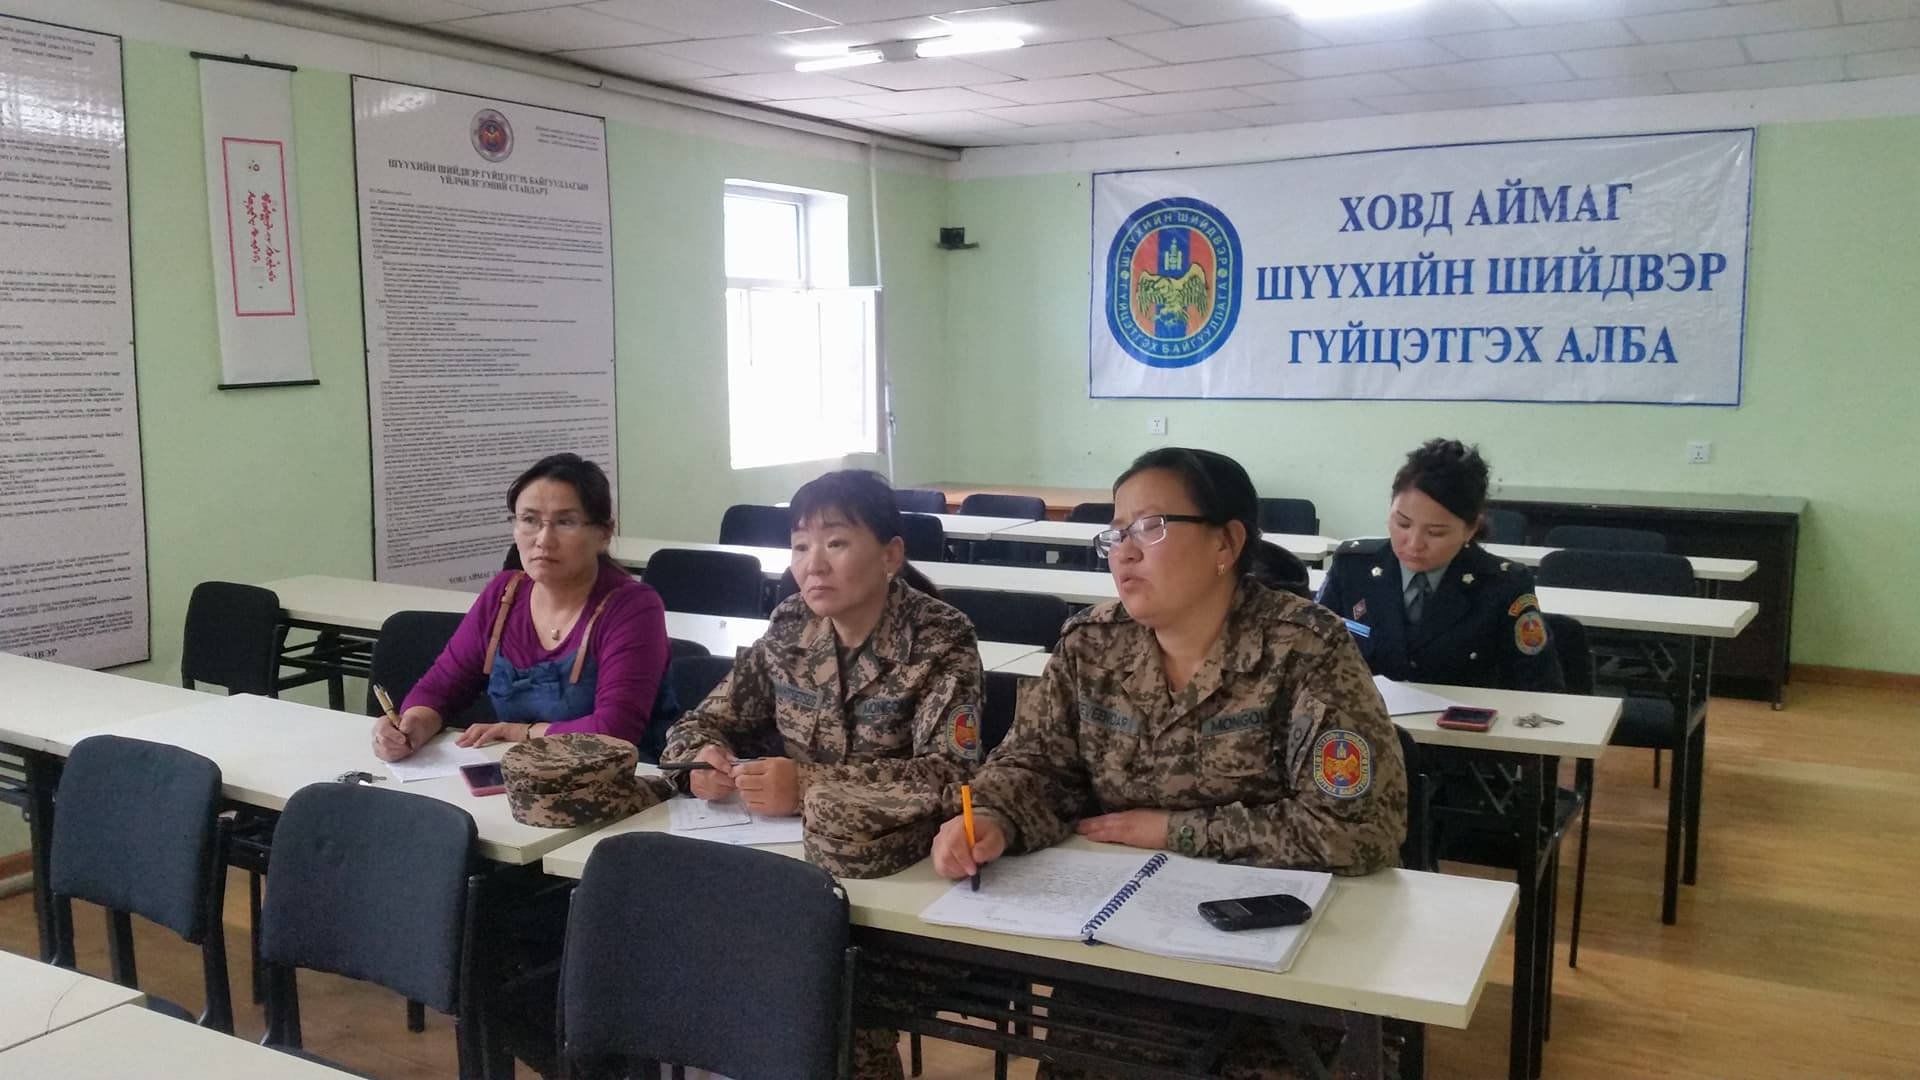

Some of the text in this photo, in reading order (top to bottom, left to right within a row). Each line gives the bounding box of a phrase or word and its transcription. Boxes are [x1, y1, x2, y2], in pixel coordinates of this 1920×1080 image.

[1338, 178, 1633, 237] ХОВД АЙМАГ
[1257, 246, 1727, 302] ШҮҮХИЙН ШИЙДВЭР
[1288, 320, 1679, 371] ГҮЙЦЭТГЭХ АЛБА
